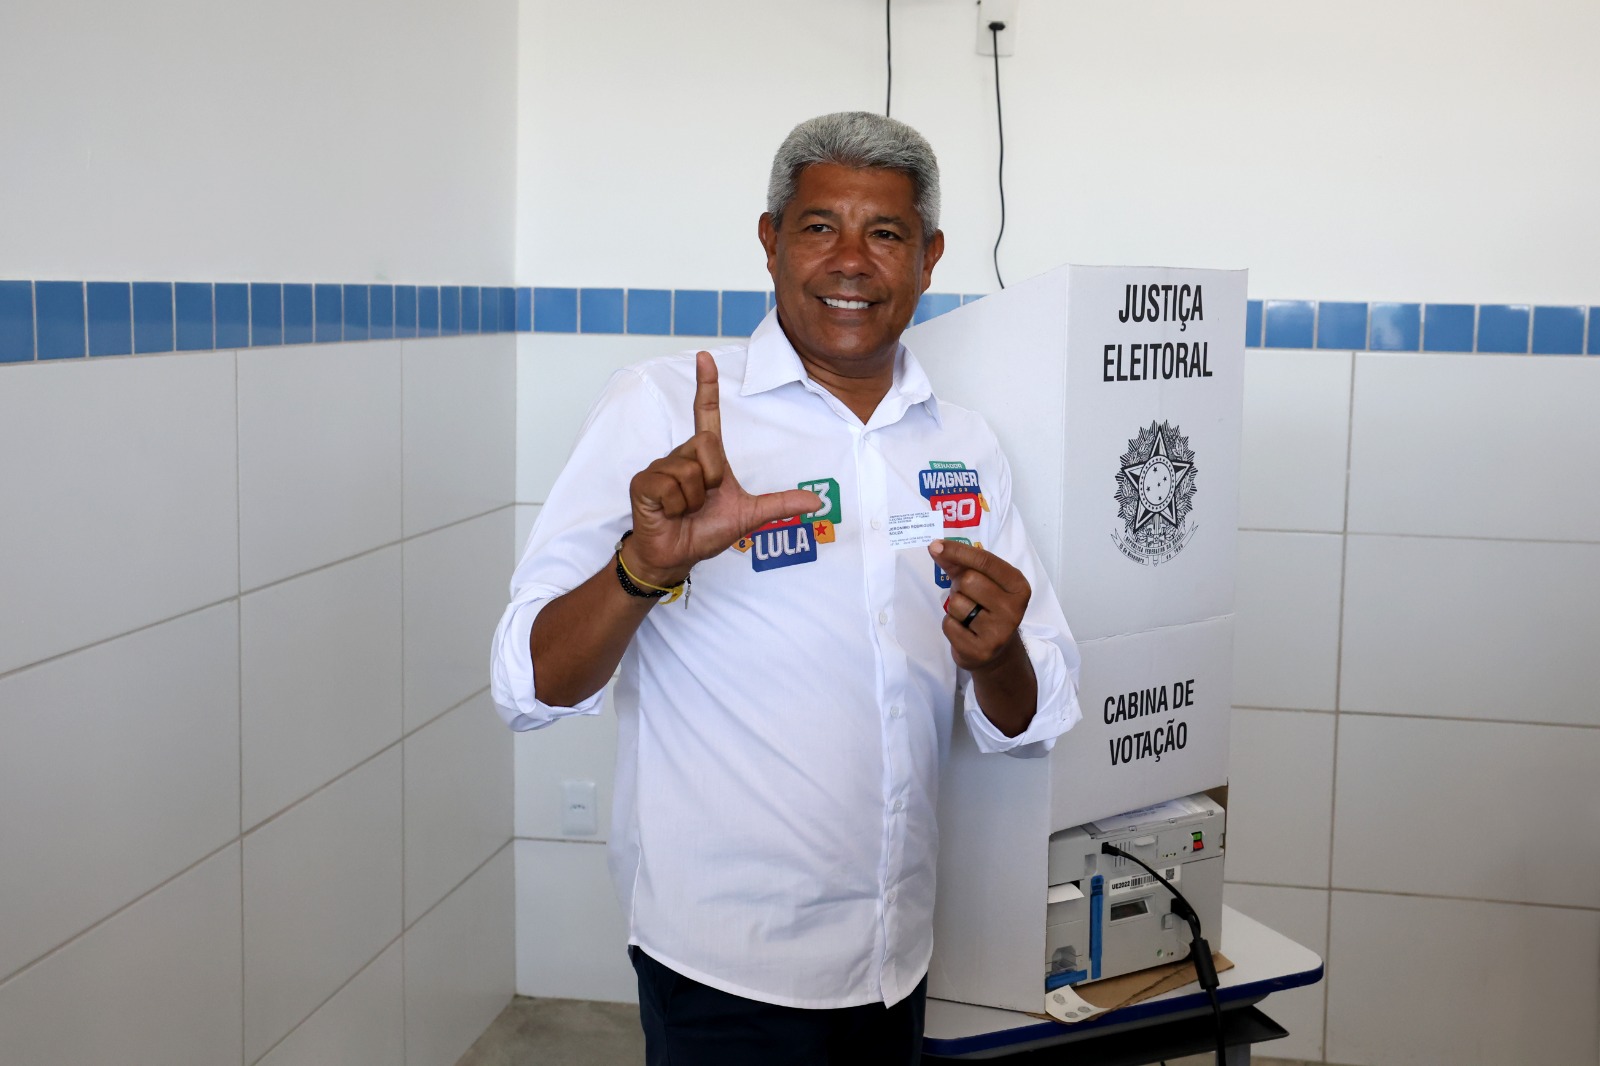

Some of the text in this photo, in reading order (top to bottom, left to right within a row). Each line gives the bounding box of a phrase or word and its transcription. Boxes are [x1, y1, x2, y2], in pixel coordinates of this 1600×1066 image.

[1119, 284, 1203, 331] JUSTIÇA
[1104, 342, 1212, 382] ELEITORAL
[922, 471, 979, 489] WAGNER
[738, 539, 746, 549] e
[755, 527, 811, 561] LULA
[1104, 679, 1194, 725] CABINA DE
[1109, 719, 1188, 766] VOTAÇÃO
[1111, 880, 1131, 890] UE2022
